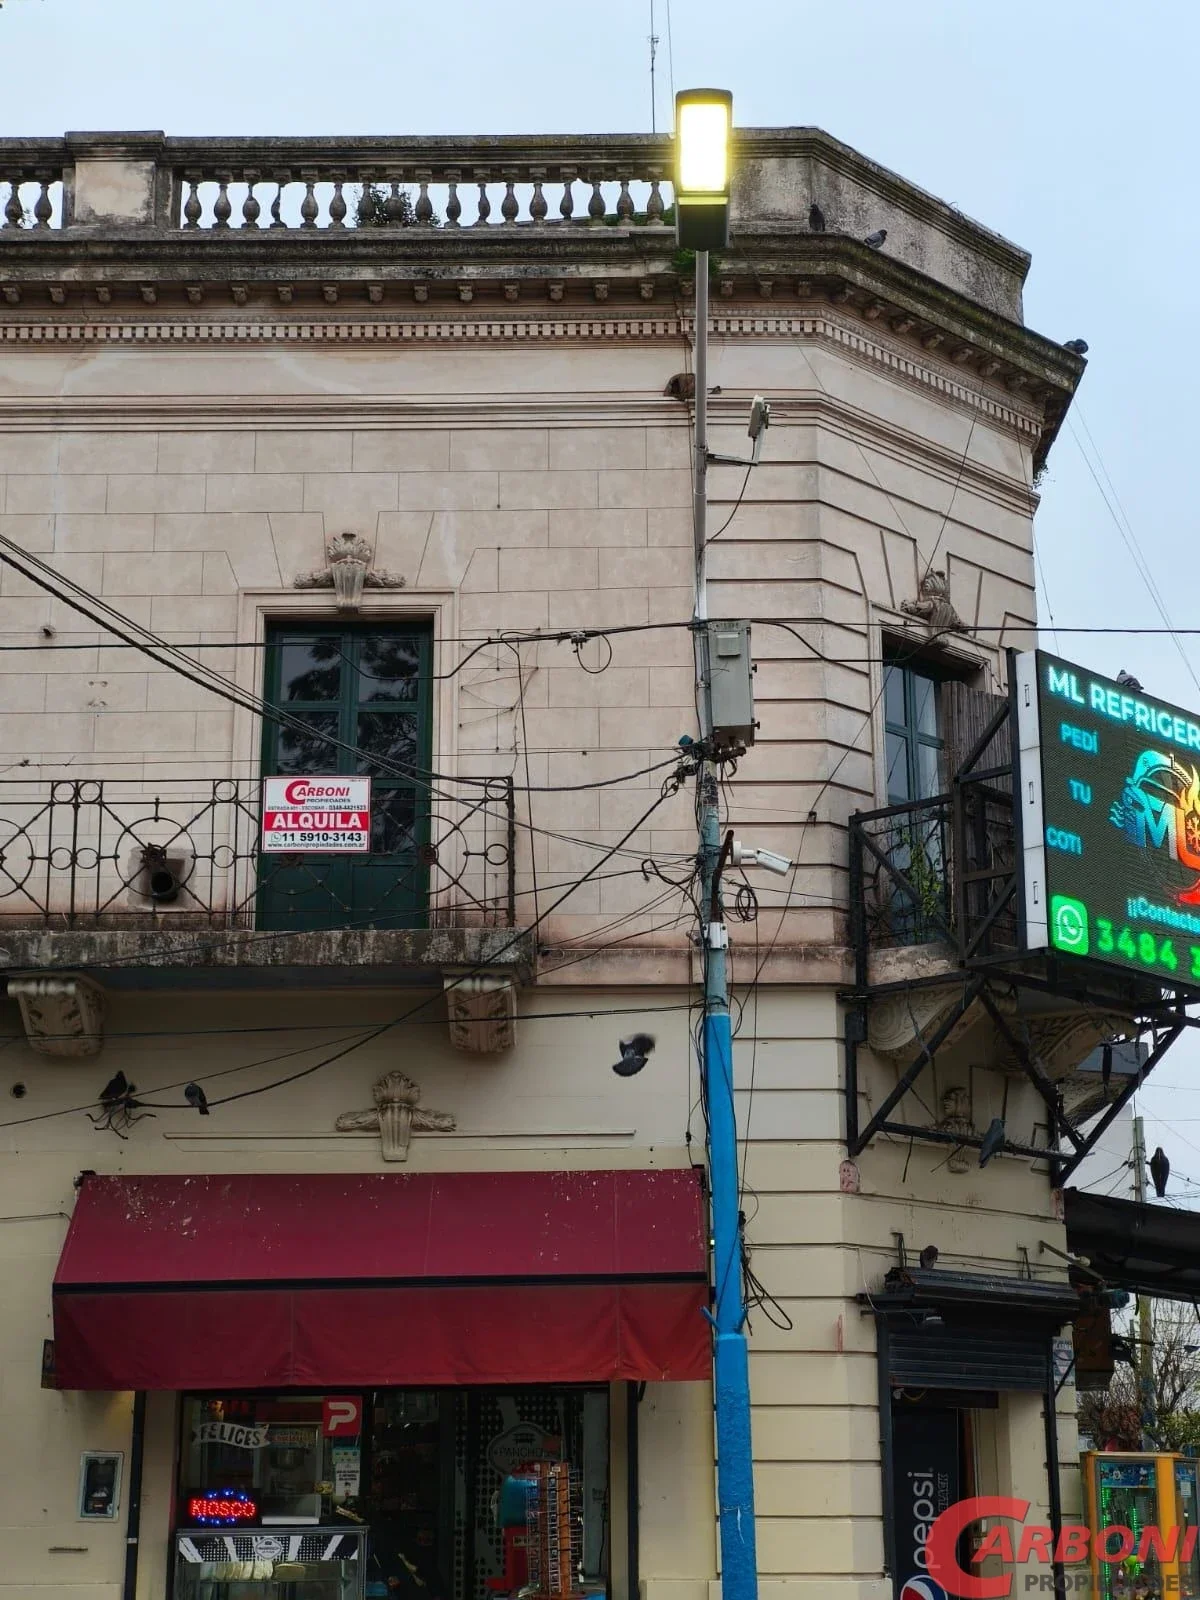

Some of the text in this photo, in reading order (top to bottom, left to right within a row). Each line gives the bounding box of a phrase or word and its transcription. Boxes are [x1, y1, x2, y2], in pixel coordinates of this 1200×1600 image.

[1049, 665, 1200, 750] ML REFRIGER
[285, 780, 350, 805] CARBONI
[1069, 779, 1092, 805] TU
[272, 813, 362, 829] ALQUILA
[282, 832, 295, 842] 11
[300, 832, 362, 842] 5910-3143
[1097, 918, 1178, 970] 3484
[201, 1423, 260, 1446] FELICES
[191, 1500, 255, 1516] KIOSCO
[907, 1471, 941, 1569] pepsi
